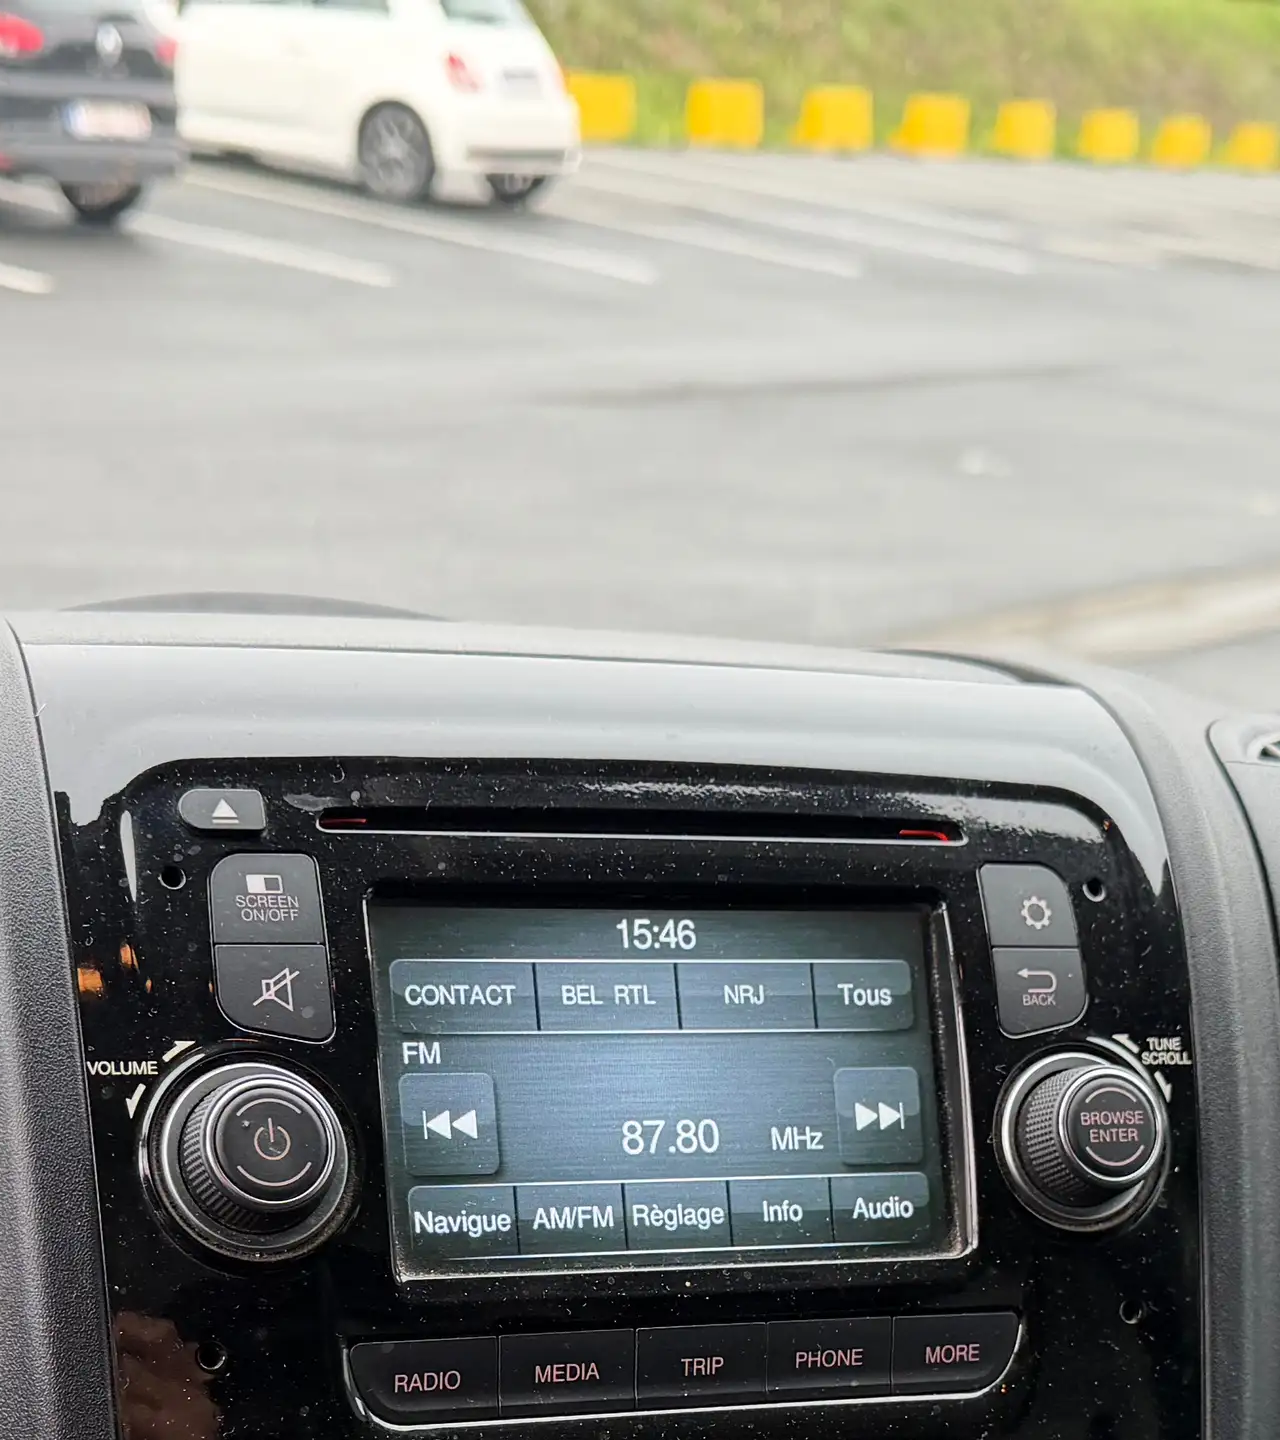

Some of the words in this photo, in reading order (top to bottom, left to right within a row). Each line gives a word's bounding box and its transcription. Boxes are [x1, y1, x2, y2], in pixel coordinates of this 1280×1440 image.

[235, 894, 299, 908] SCREEN
[241, 908, 299, 922] ON/OFF
[616, 918, 697, 951] 15:46
[404, 984, 516, 1006] CONTACT
[561, 984, 604, 1006] BEL
[614, 984, 656, 1006] RTL
[723, 984, 765, 1006] NRJ
[837, 983, 892, 1006] Tous
[1022, 994, 1056, 1007] BACK
[402, 1042, 441, 1065] FM
[1146, 1037, 1182, 1052] TUNE
[87, 1060, 158, 1077] VOLUME
[1141, 1053, 1192, 1066] SCROLL
[1080, 1111, 1144, 1127] BROWSE
[621, 1119, 720, 1155] 87.80
[770, 1128, 824, 1151] MHz
[1089, 1127, 1139, 1143] ENTER
[532, 1206, 614, 1230] AM/FM
[762, 1201, 803, 1223] Info
[853, 1197, 914, 1220] Audio
[413, 1210, 512, 1238] Navigue
[794, 1348, 864, 1370] PHONE
[924, 1343, 981, 1364] MORE
[534, 1362, 600, 1384] MEDIA
[680, 1356, 725, 1378] TRIP
[393, 1370, 461, 1393] RADIO
